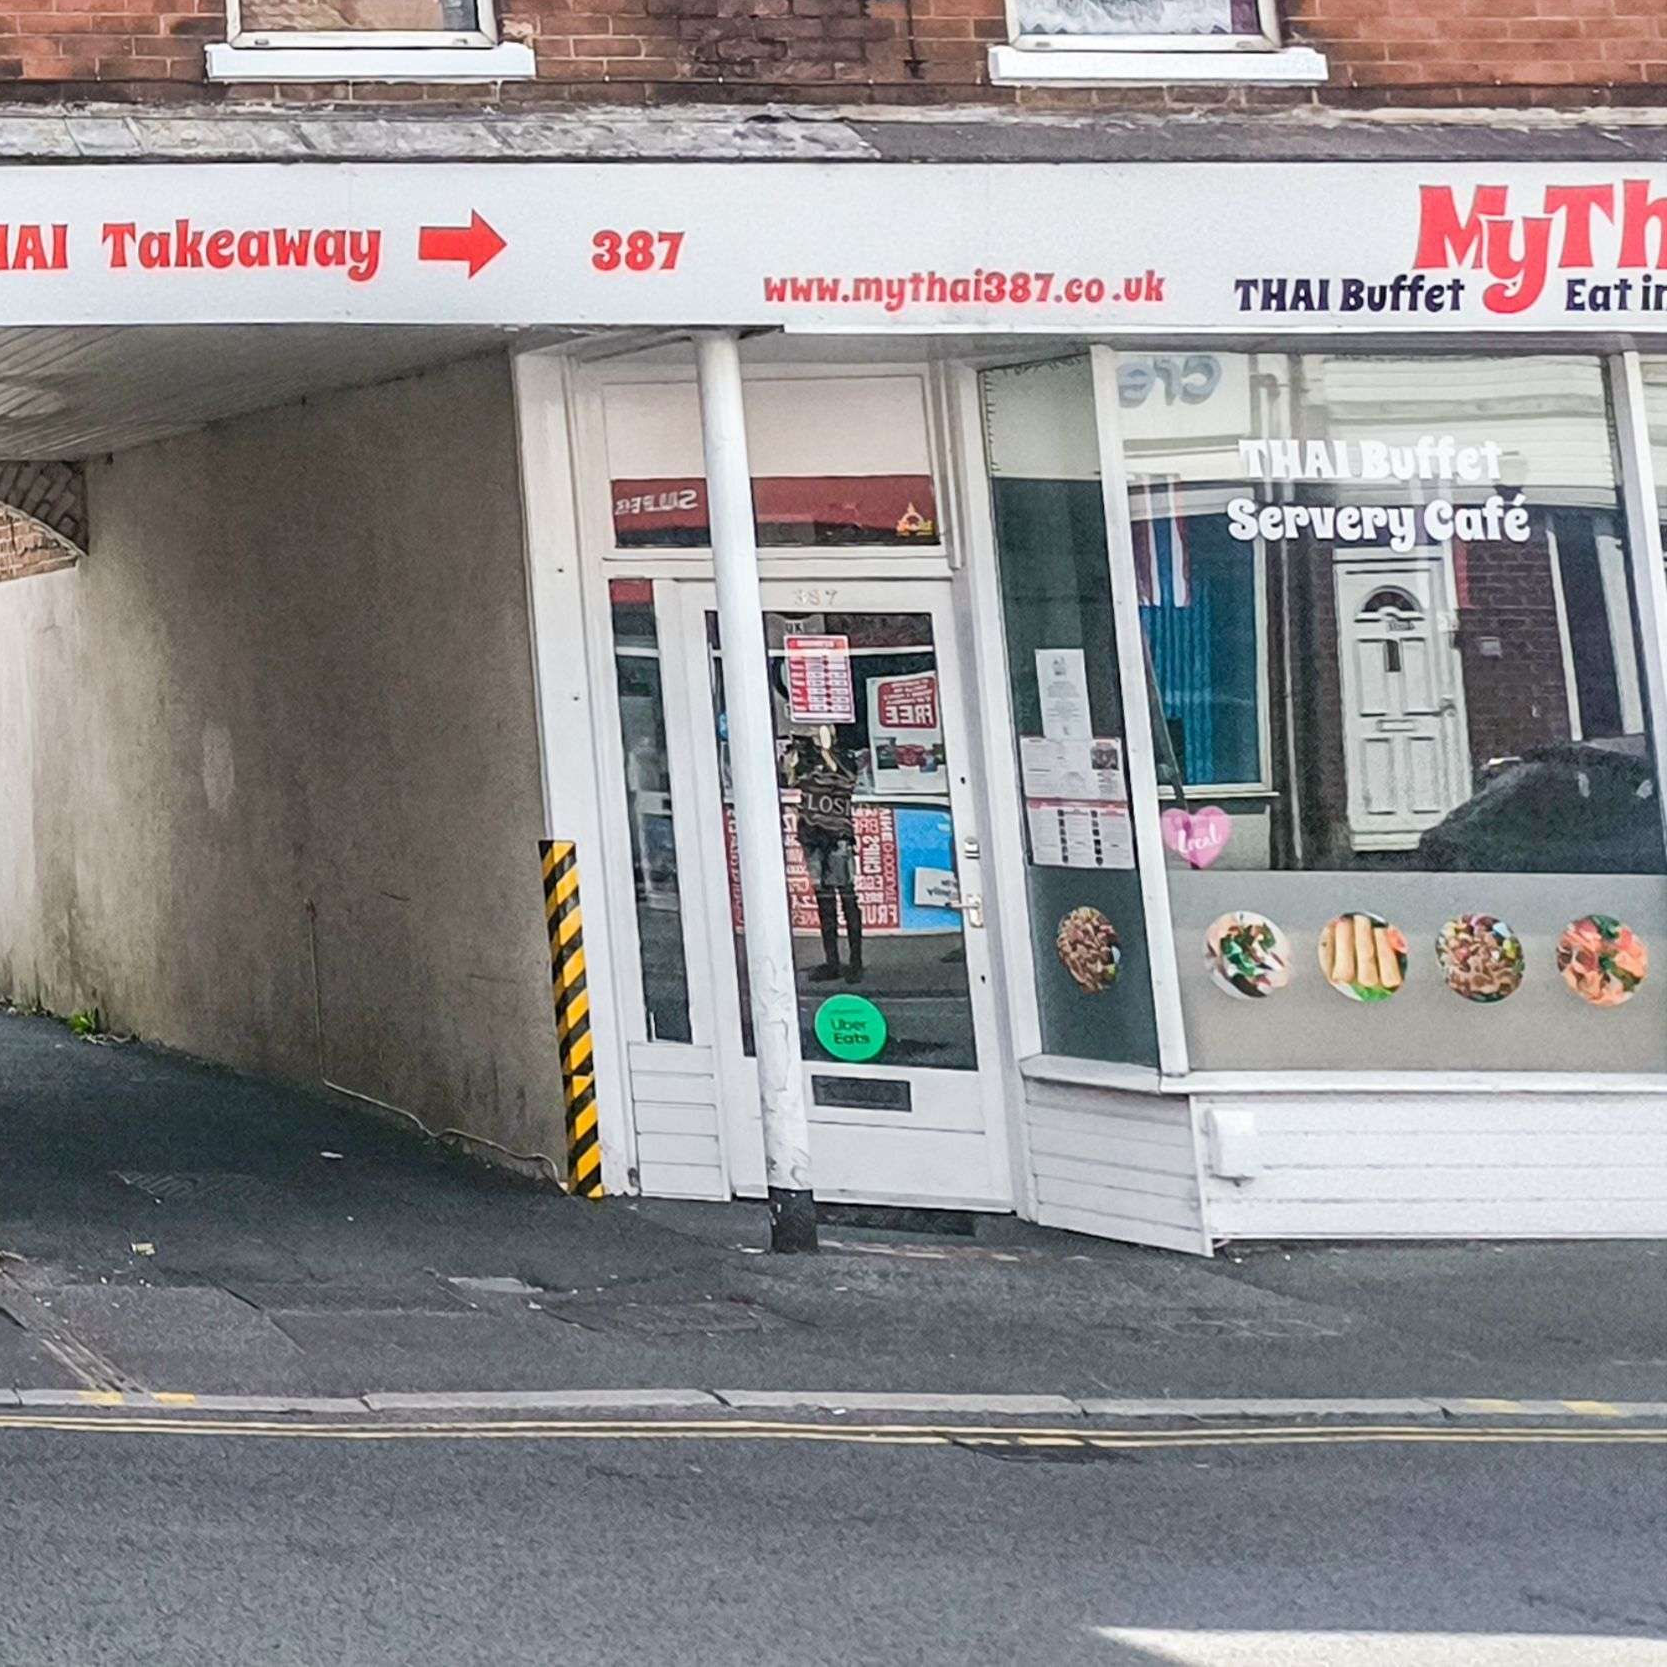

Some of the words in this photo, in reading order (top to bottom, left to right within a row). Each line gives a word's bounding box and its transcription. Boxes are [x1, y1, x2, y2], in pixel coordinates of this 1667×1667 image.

[101, 219, 382, 283] Takeaway
[591, 230, 685, 272] 387
[1234, 277, 1331, 312] THAI
[1340, 274, 1465, 313] Buffet
[1565, 277, 1632, 312] Eat
[1239, 438, 1350, 482] THAI
[1360, 438, 1503, 482] Buffet
[1227, 497, 1417, 552] Servery
[1423, 493, 1531, 544] Café
[830, 1018, 867, 1034] Uber
[832, 1031, 870, 1046] Eats
